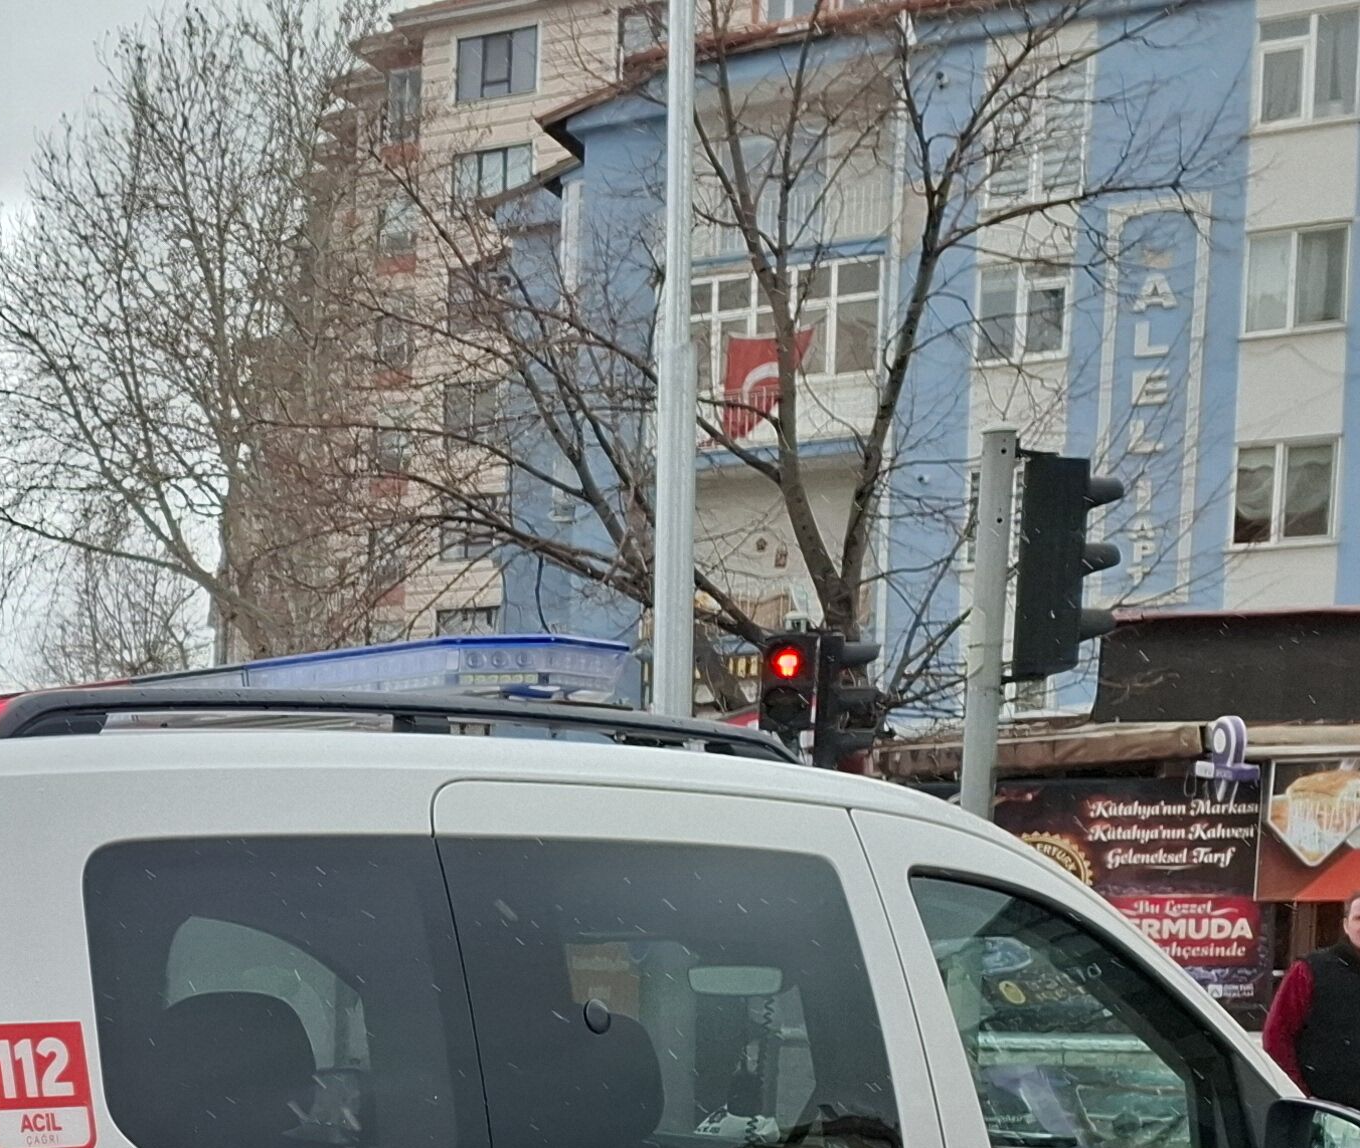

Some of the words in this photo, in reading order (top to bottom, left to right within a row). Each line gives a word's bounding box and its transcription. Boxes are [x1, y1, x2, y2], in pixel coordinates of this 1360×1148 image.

[1106, 848, 1187, 870] Geleneksel
[1134, 900, 1160, 915] Bu
[1164, 900, 1214, 917] Lezzet
[1158, 942, 1246, 960] ahçesinde
